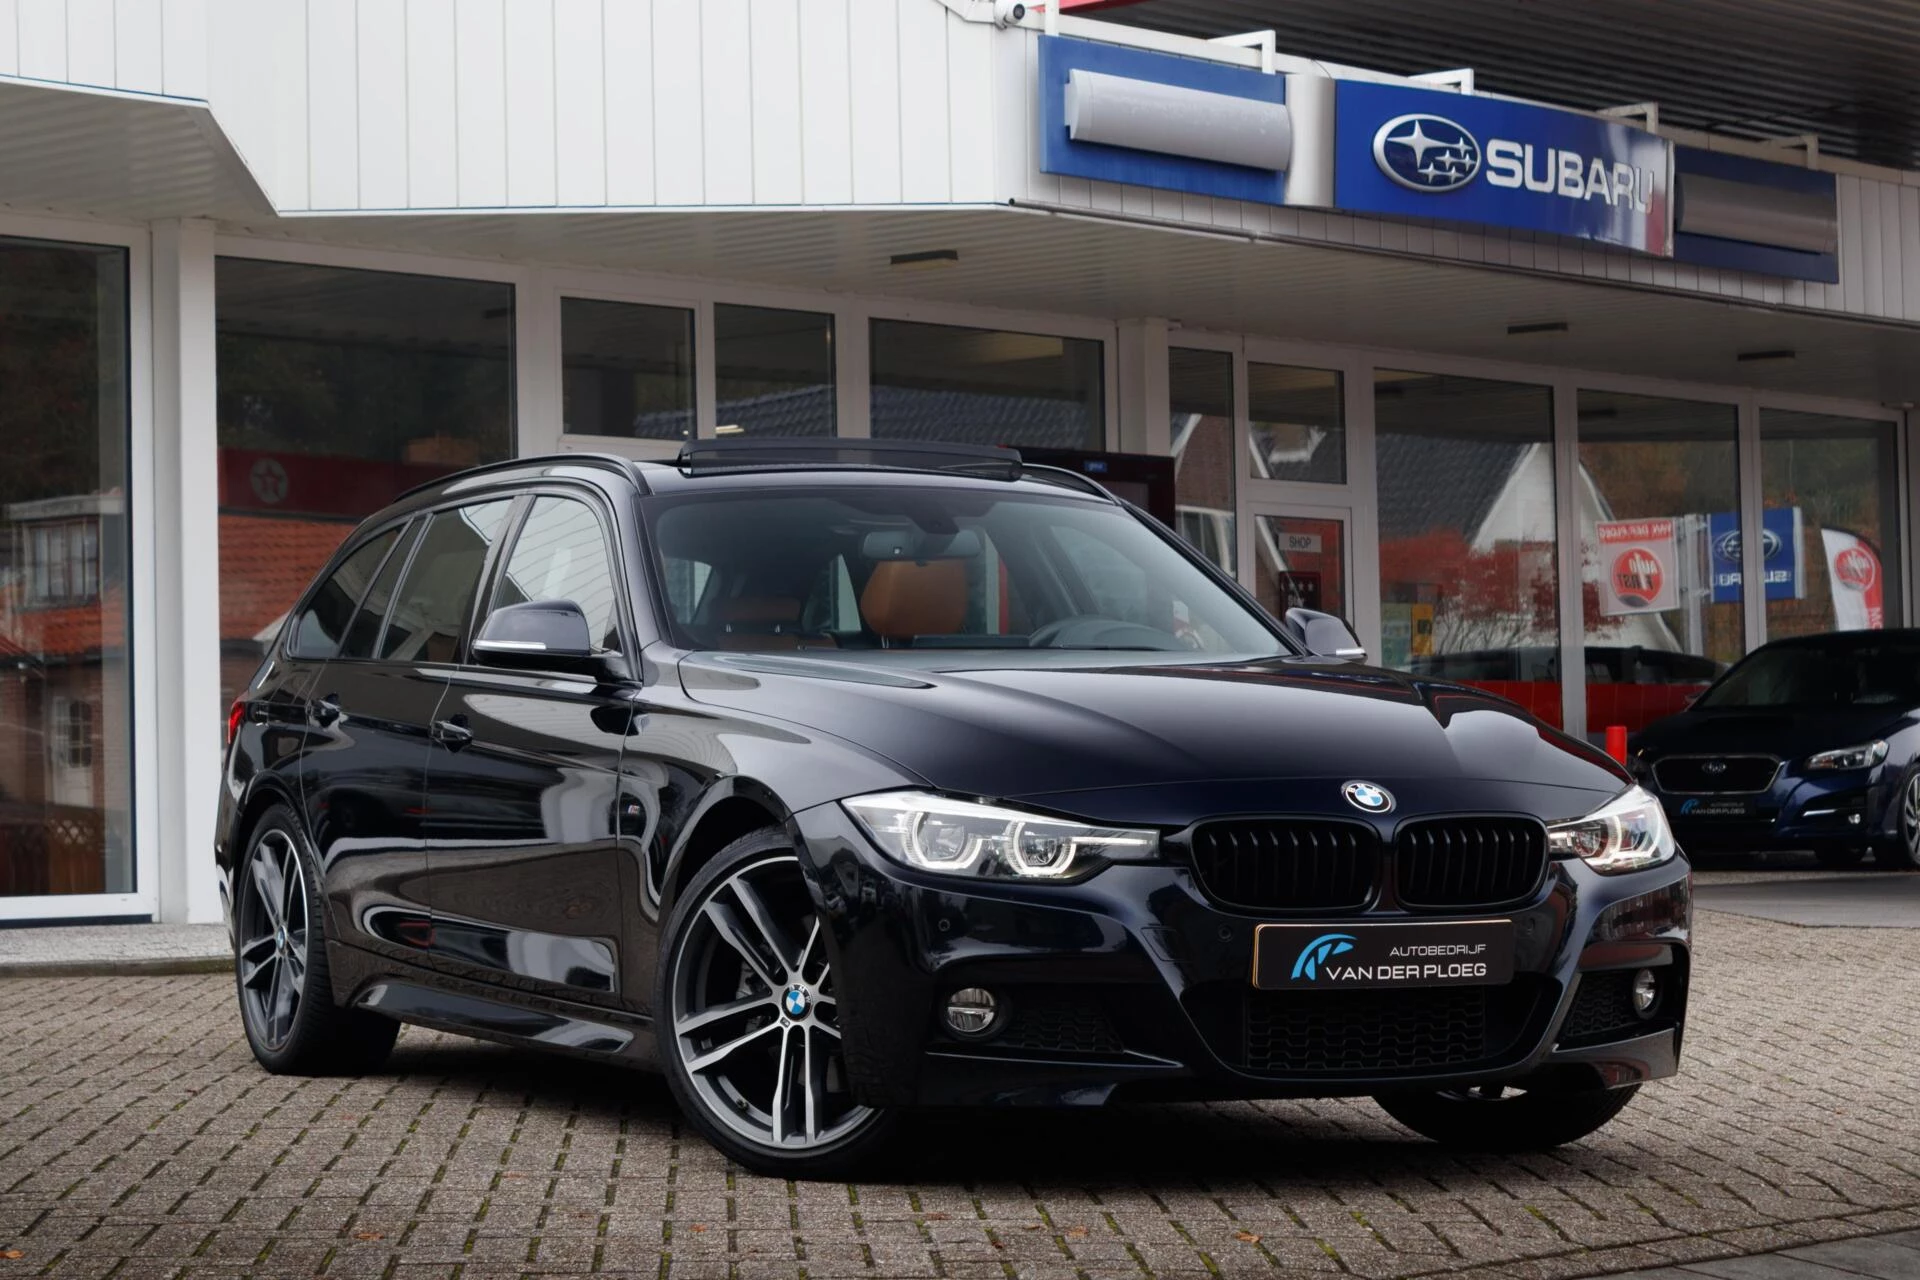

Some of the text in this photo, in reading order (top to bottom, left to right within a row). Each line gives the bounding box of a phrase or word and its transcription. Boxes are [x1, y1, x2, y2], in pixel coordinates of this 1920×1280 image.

[1486, 139, 1655, 214] SUBARU
[1289, 536, 1312, 549] SHOP
[1390, 944, 1487, 957] AUTOBEDRIJF
[1326, 963, 1487, 981] VAN DER PLOEG
